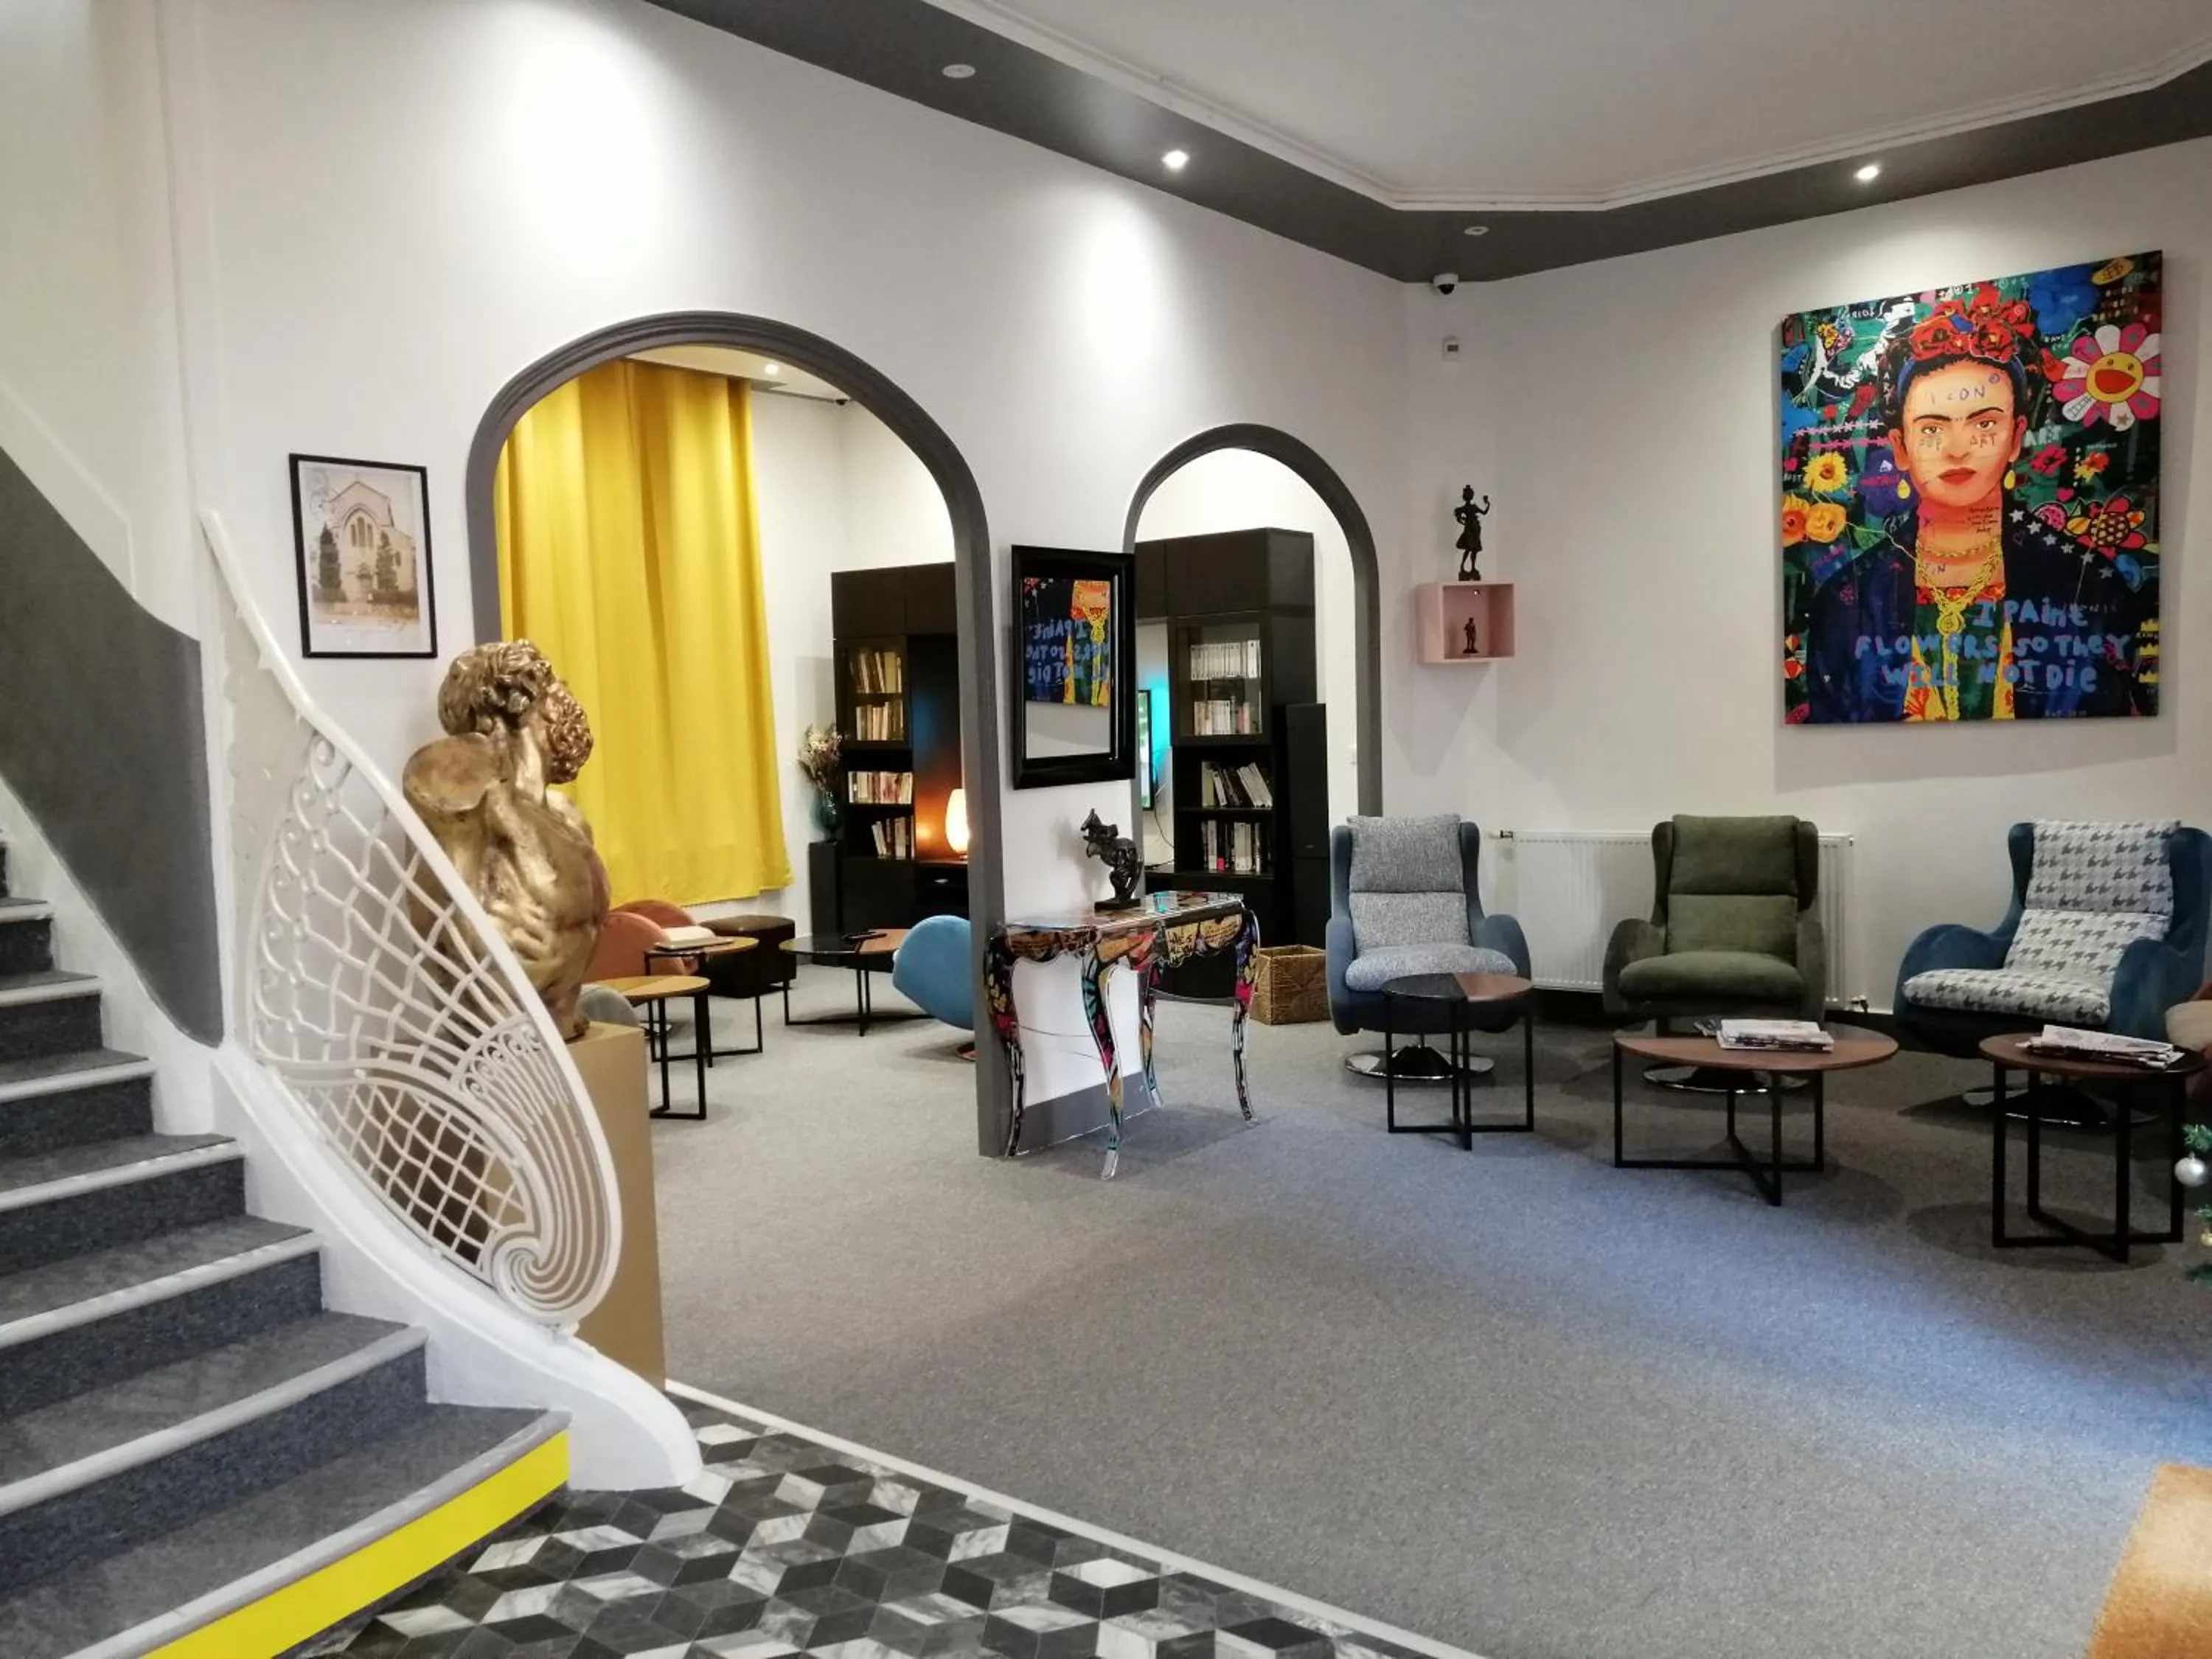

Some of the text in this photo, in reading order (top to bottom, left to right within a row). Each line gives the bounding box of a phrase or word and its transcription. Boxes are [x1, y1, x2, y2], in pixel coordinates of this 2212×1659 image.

[1972, 600, 1995, 627] I
[1882, 661, 1960, 689] WILL
[1978, 660, 2040, 684] NOT
